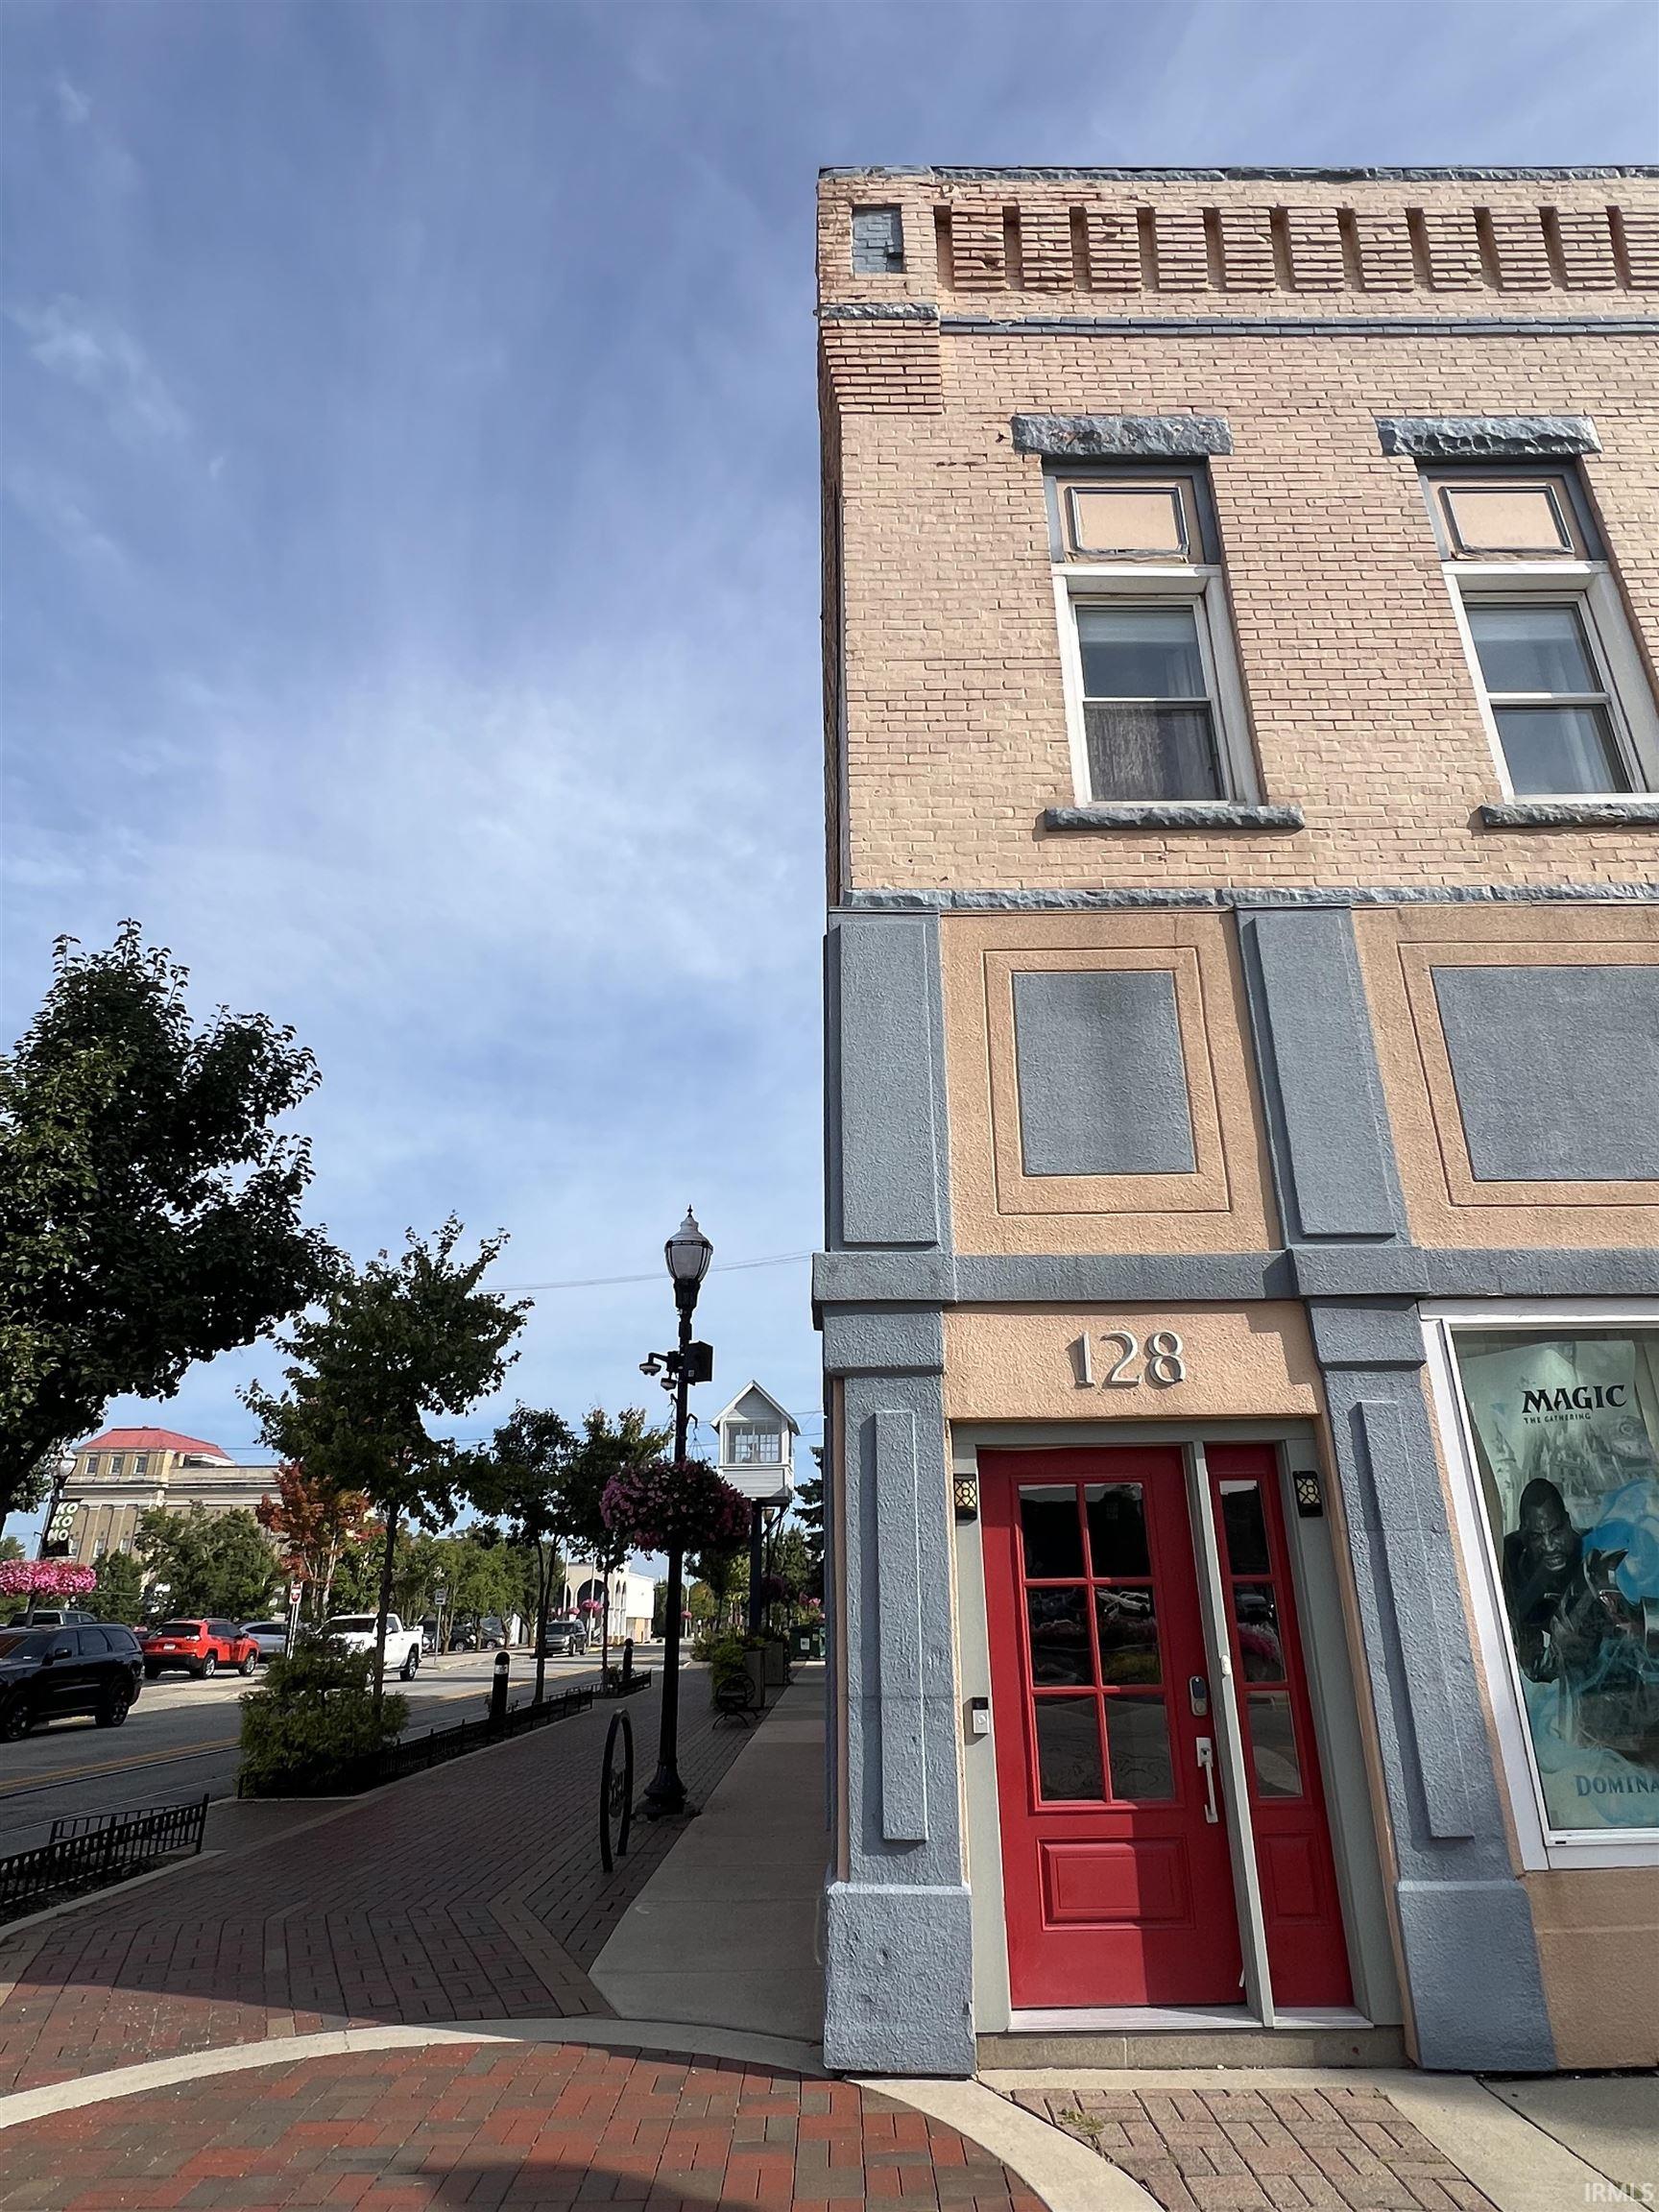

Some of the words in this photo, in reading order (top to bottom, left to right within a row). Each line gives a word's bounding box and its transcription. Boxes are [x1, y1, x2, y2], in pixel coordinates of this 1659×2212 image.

[1066, 1330, 1186, 1389] 128
[1522, 1384, 1627, 1413] MAGIC
[1544, 1412, 1592, 1423] GATHERING
[55, 1502, 80, 1515] KO
[50, 1515, 74, 1527] KO
[46, 1528, 69, 1541] MO
